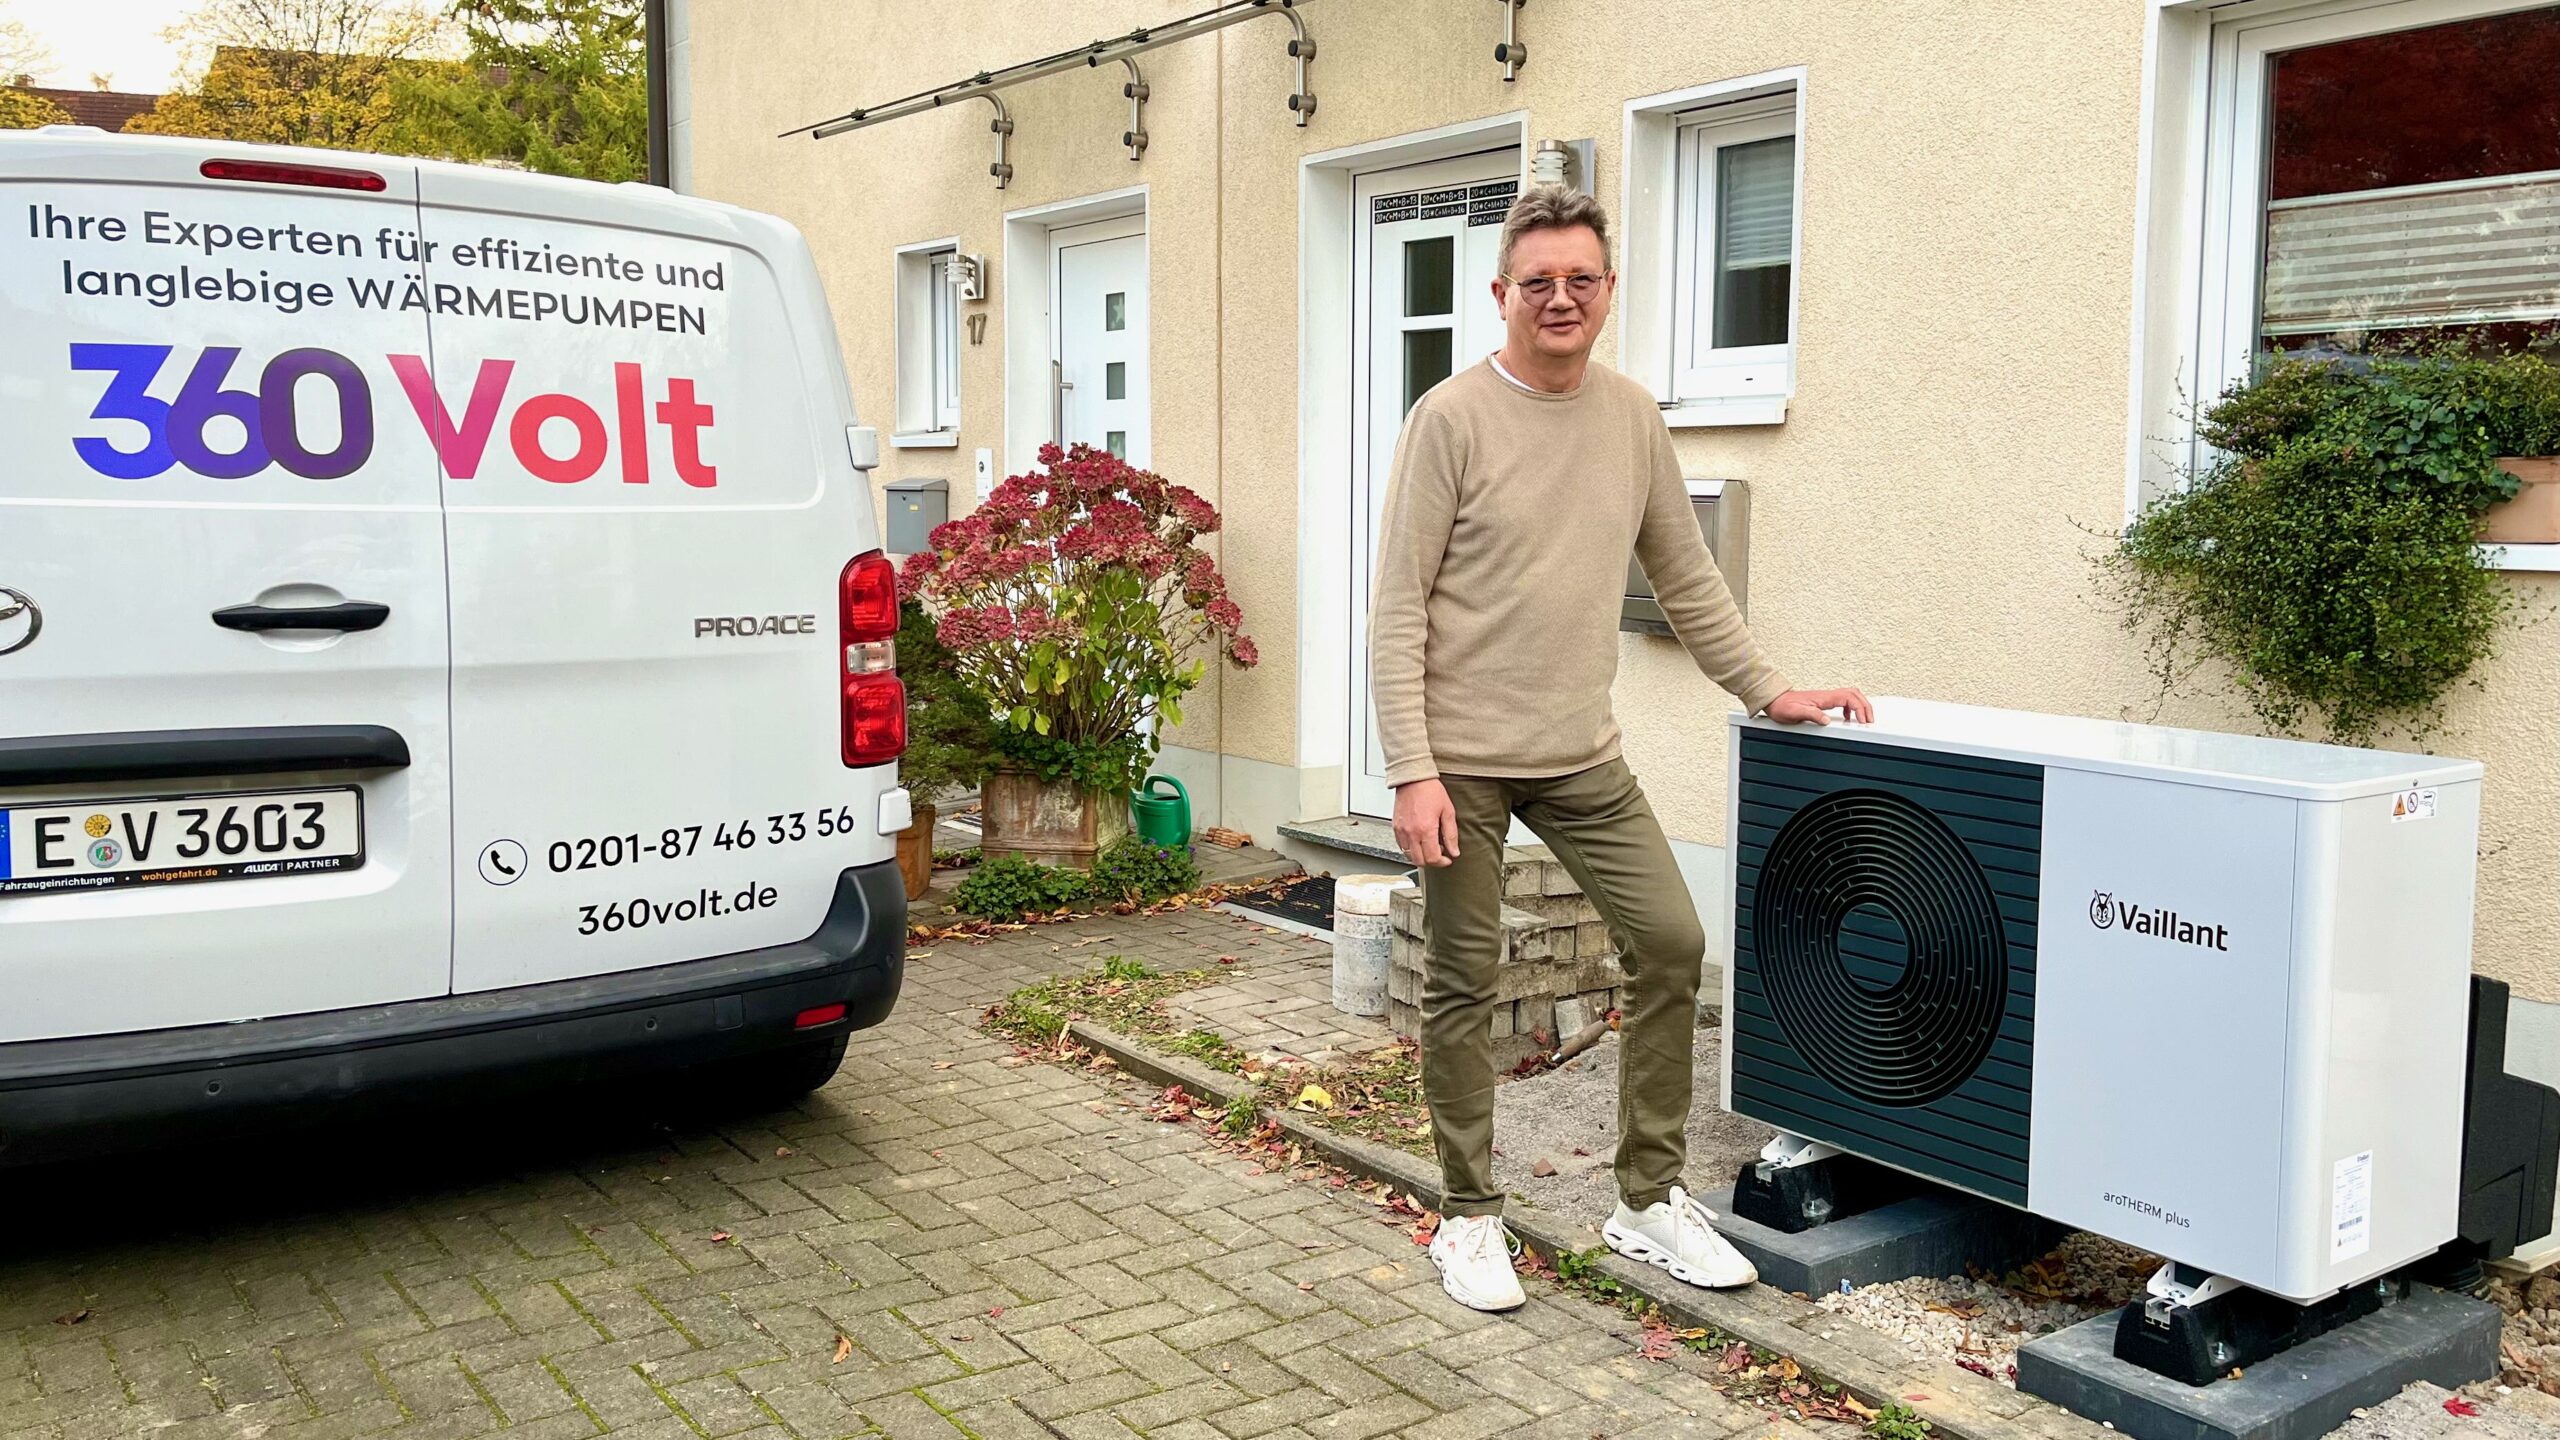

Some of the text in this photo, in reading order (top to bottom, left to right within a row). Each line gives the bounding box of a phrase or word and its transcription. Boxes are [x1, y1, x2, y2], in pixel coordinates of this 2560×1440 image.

[29, 204, 725, 292] Ihre Experten für effiziente und
[63, 259, 706, 335] langlebige WÄRMEPUMPEN
[966, 312, 987, 346] 17
[694, 614, 816, 638] PROACE
[35, 801, 325, 869] E V 3603
[548, 805, 855, 873] 0201-87 46 33 56
[141, 868, 218, 881] wohlgefahrt.de
[287, 858, 340, 870] PARTNER
[577, 881, 778, 936] 360volt.de
[2118, 901, 2229, 952] Vaillant
[2103, 1191, 2190, 1228] aroTHERM plus
